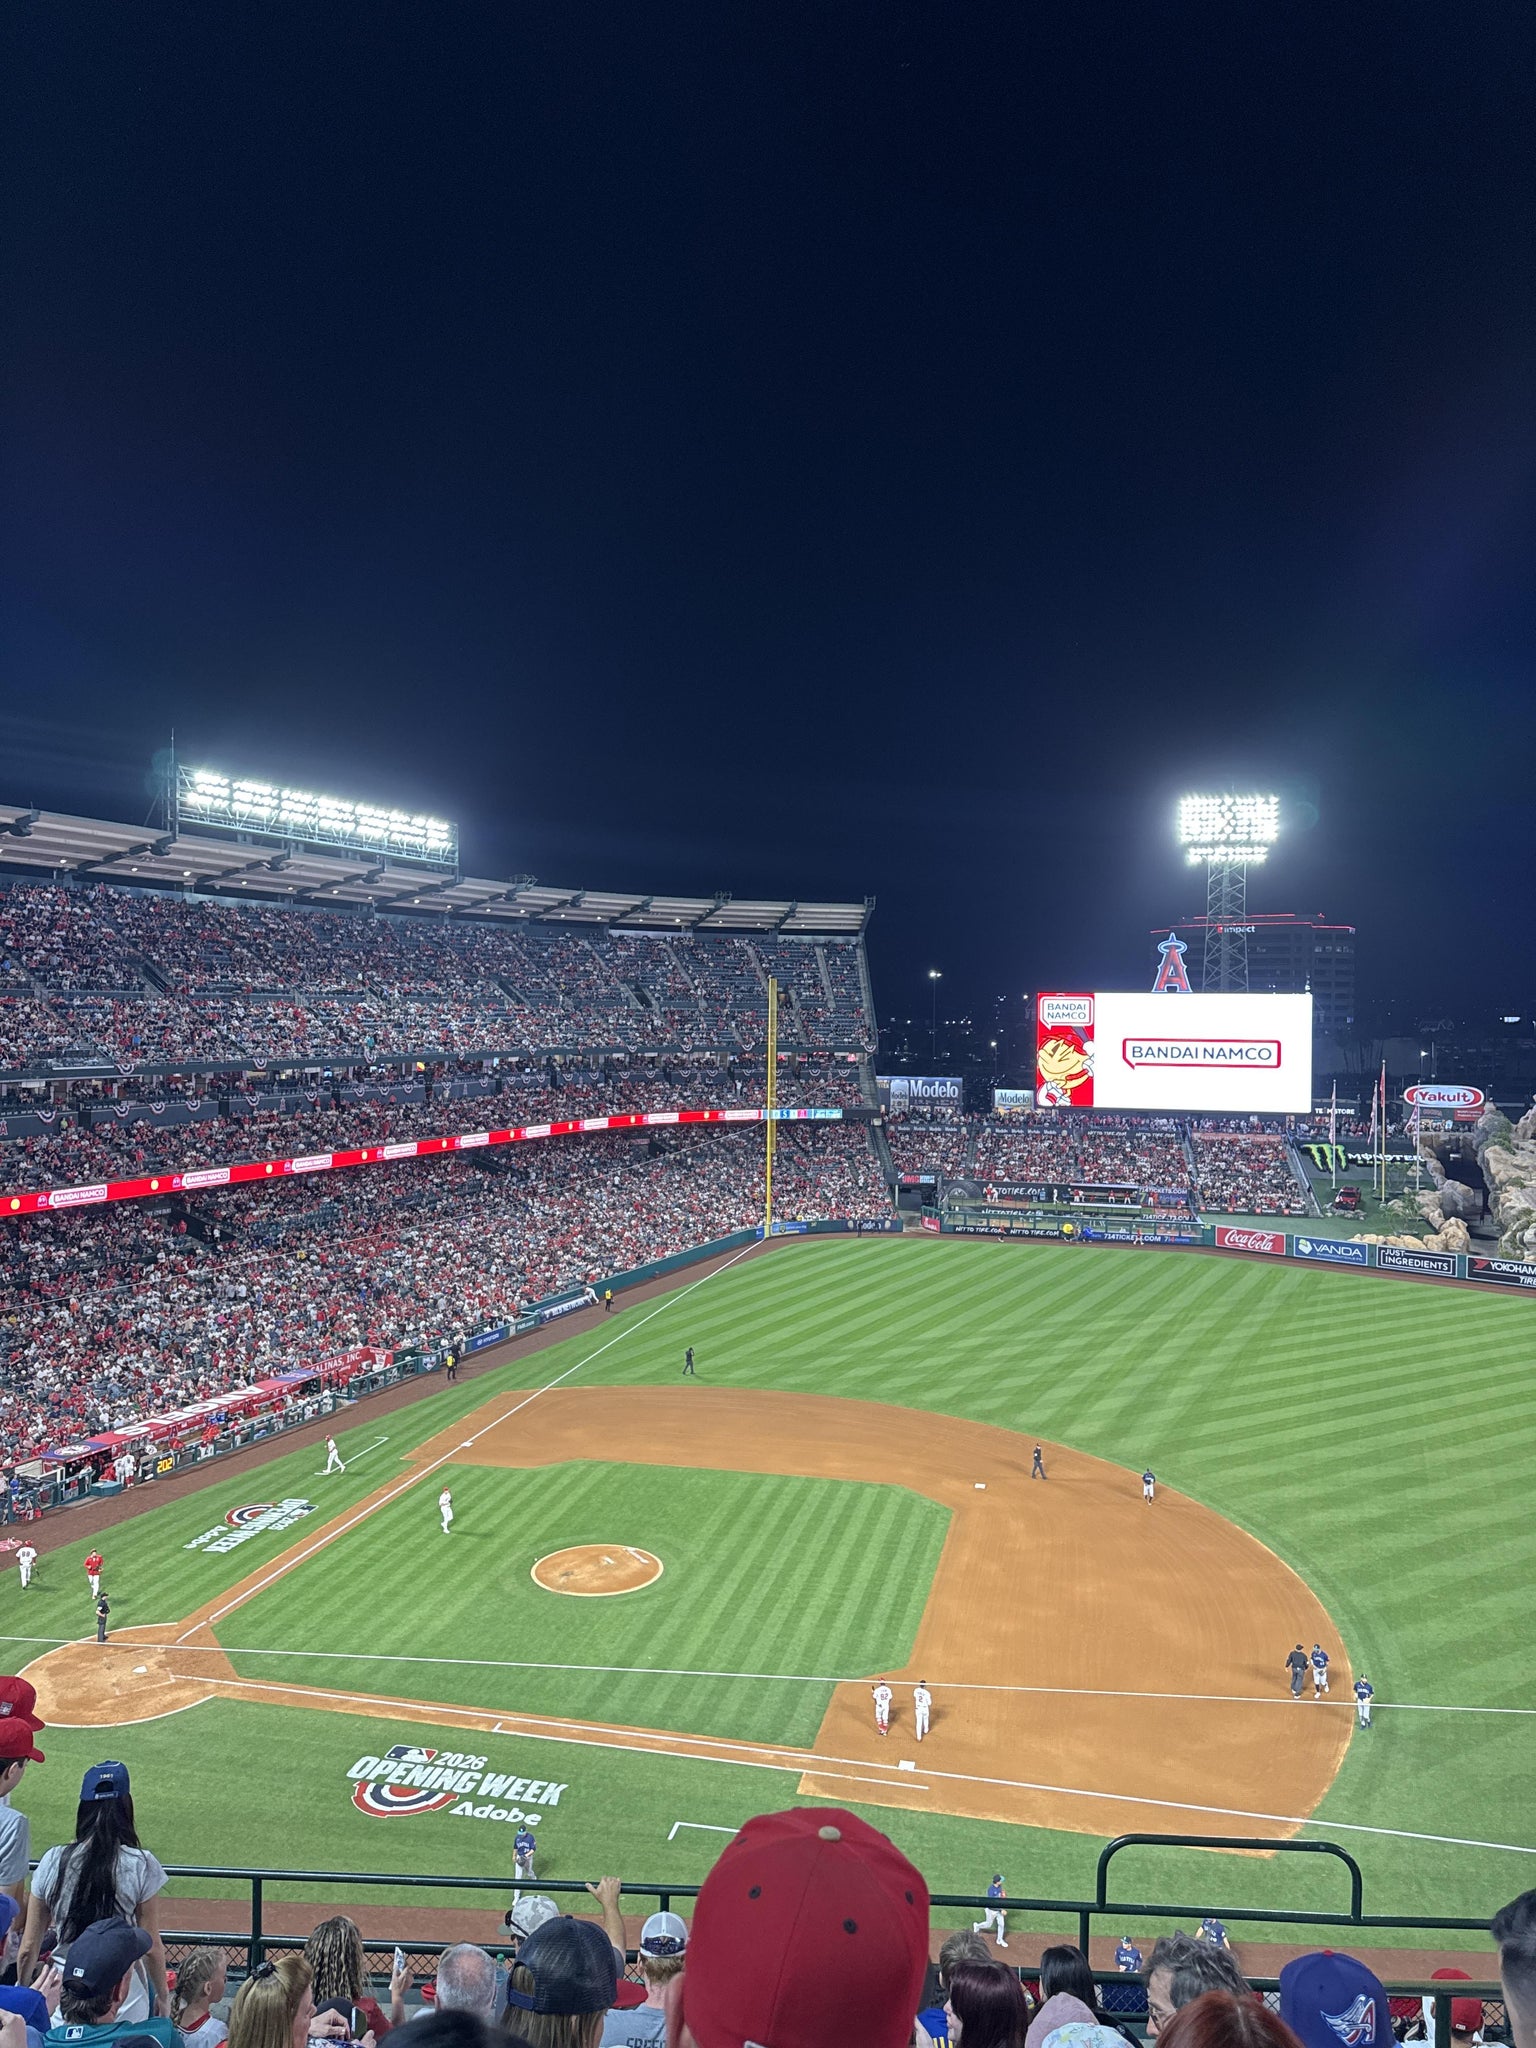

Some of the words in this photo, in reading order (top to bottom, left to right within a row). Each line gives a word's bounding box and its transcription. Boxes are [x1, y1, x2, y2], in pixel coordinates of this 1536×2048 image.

[1047, 1003, 1086, 1011] BANDAI
[1047, 1012, 1087, 1020] NAMCO
[1132, 1045, 1199, 1060] BANDAI
[1202, 1046, 1272, 1061] NAMCO
[910, 1080, 958, 1098] Modelo
[1000, 1091, 1030, 1104] Modelo
[1419, 1091, 1471, 1102] Yakult
[54, 1192, 80, 1202] BANDAI
[80, 1189, 104, 1199] NAMCO
[1224, 1229, 1276, 1251] Coca-Cola
[1312, 1243, 1362, 1258] VANDA
[1384, 1248, 1406, 1257] JUST
[1385, 1255, 1449, 1271] INGREDIENTS
[114, 1385, 265, 1436] ANGELS
[157, 1457, 173, 1474] 202
[240, 1498, 309, 1531] OPENING
[182, 1525, 229, 1549] Adobe
[202, 1528, 260, 1553] WEEK
[433, 1751, 489, 1770] 2026
[346, 1755, 482, 1794] OPENING
[476, 1772, 569, 1806] WEEK
[448, 1801, 542, 1826] Adobe
